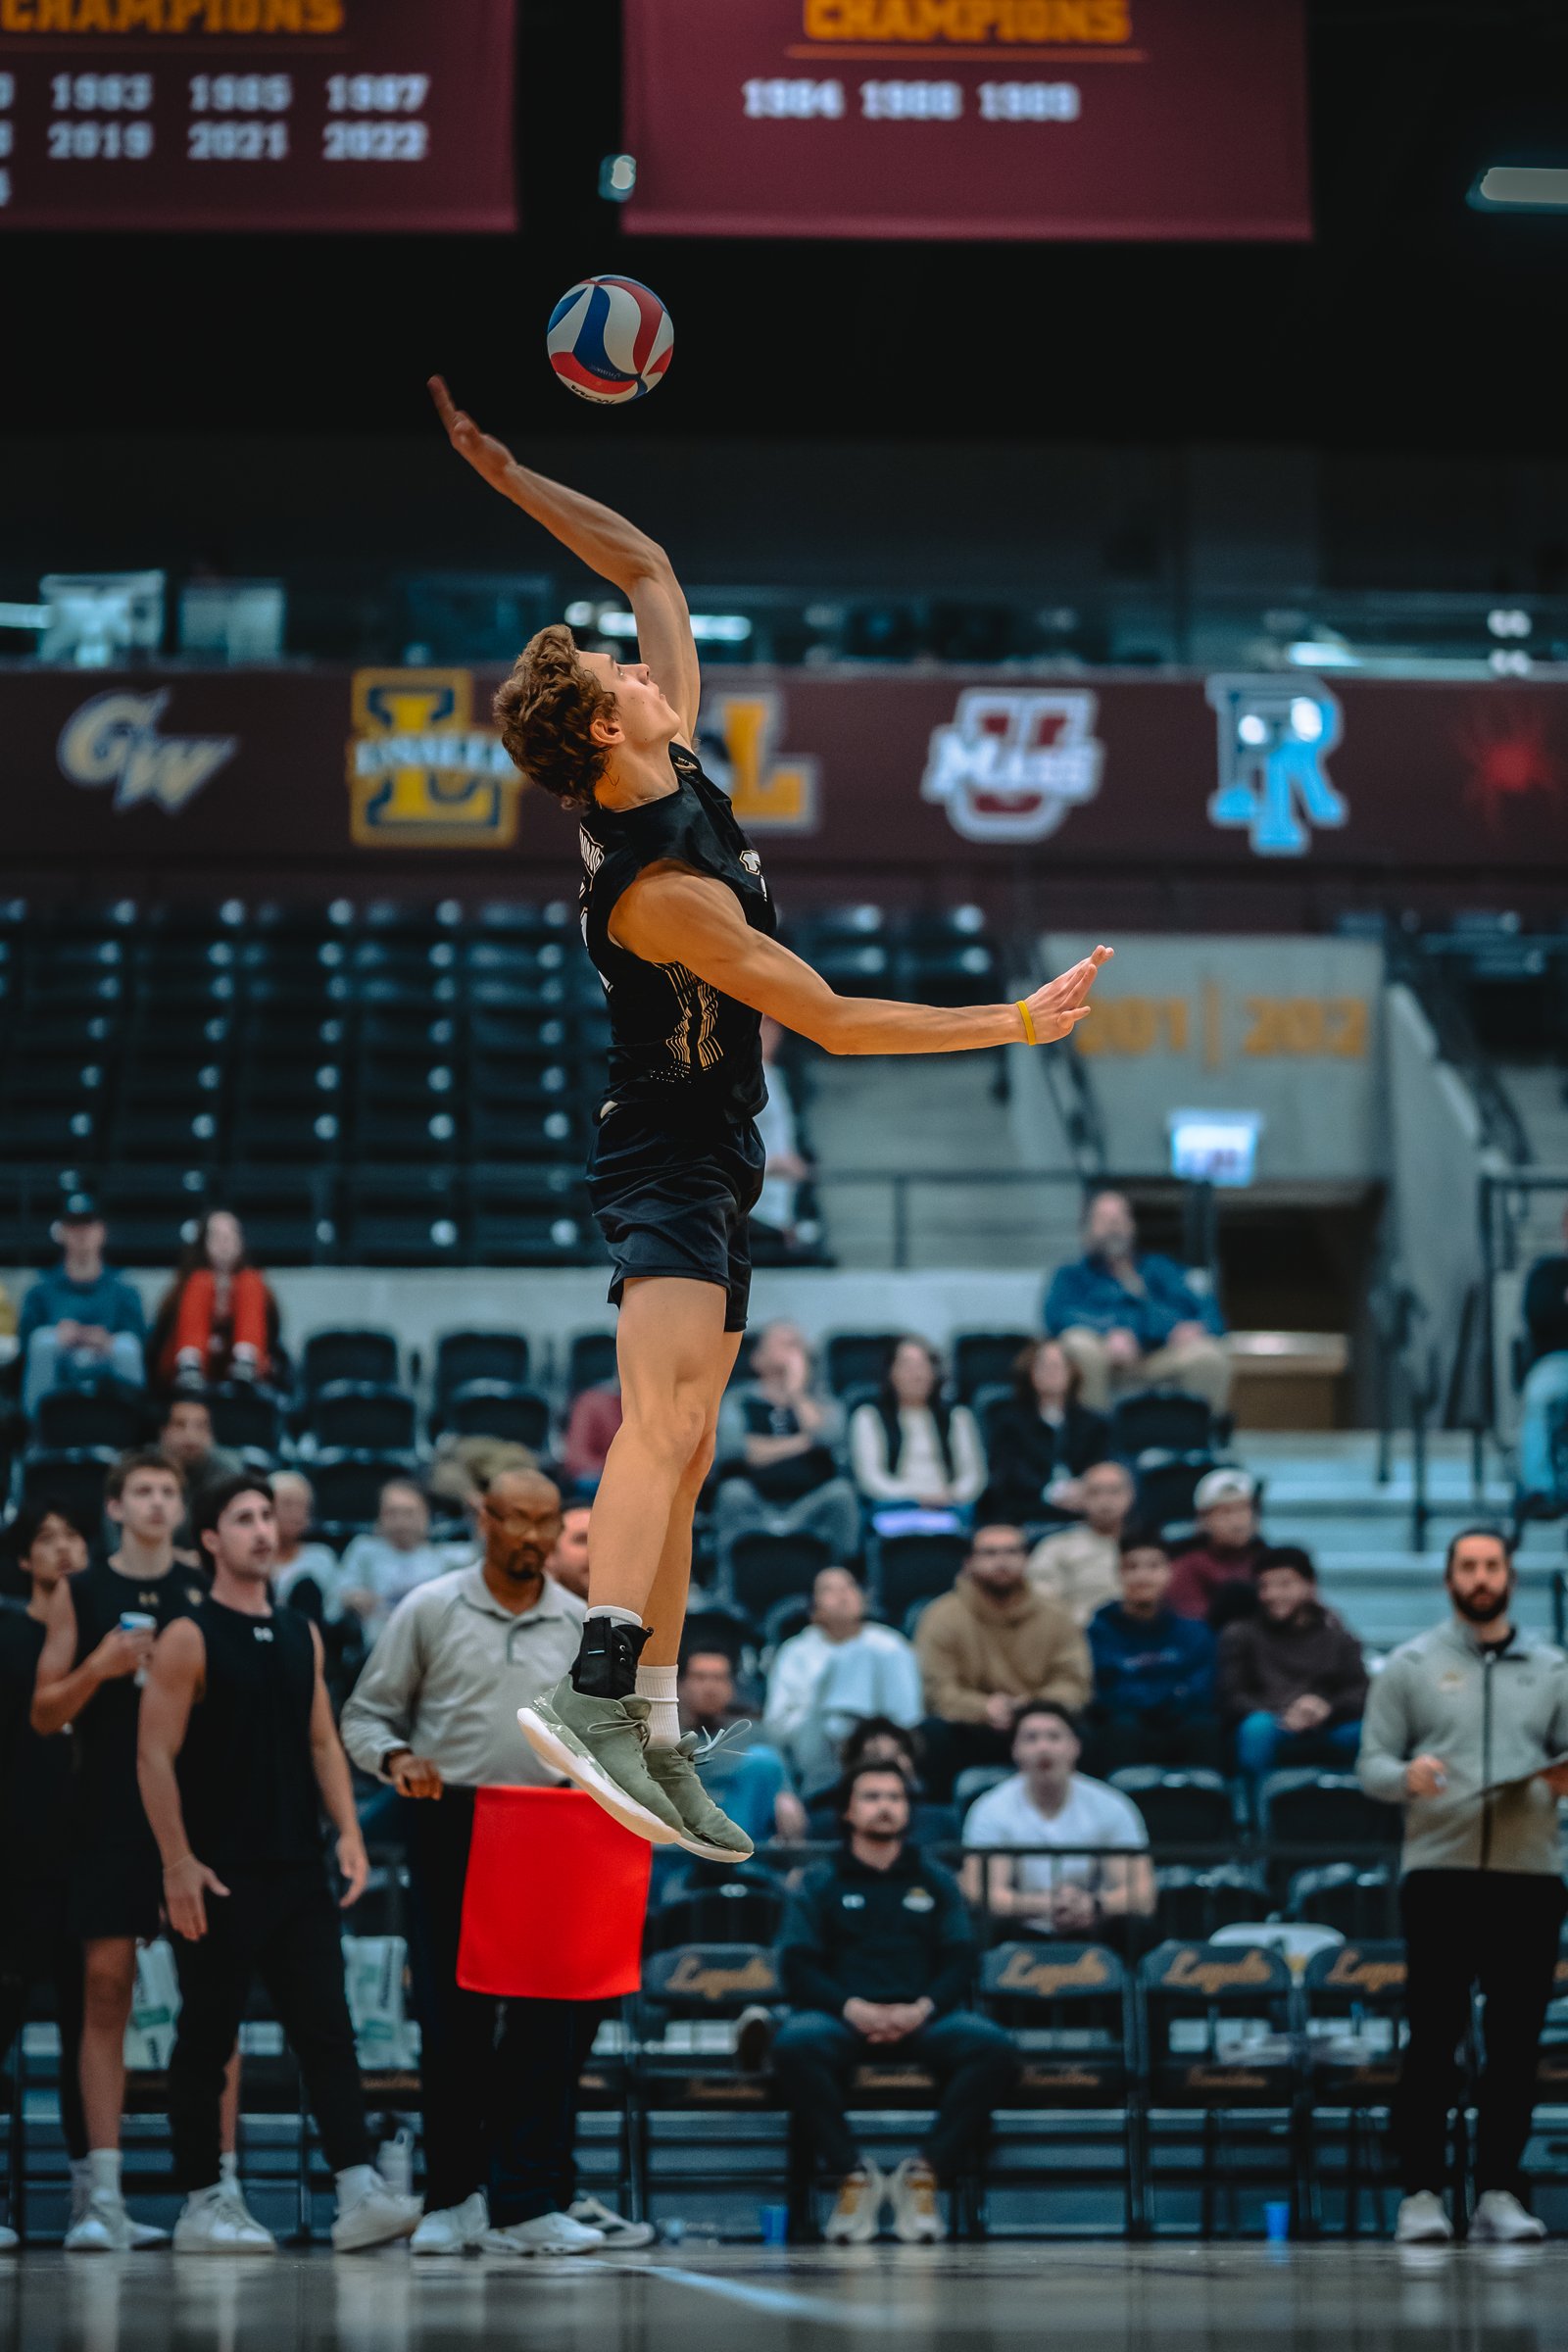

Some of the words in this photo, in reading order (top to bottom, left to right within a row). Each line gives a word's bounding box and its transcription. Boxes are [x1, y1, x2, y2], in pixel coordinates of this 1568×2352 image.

[1, 0, 345, 33] CHAMPIONS
[804, 0, 1131, 42] CHAMPIONS
[187, 121, 288, 160] 2021
[1242, 995, 1369, 1058] 202
